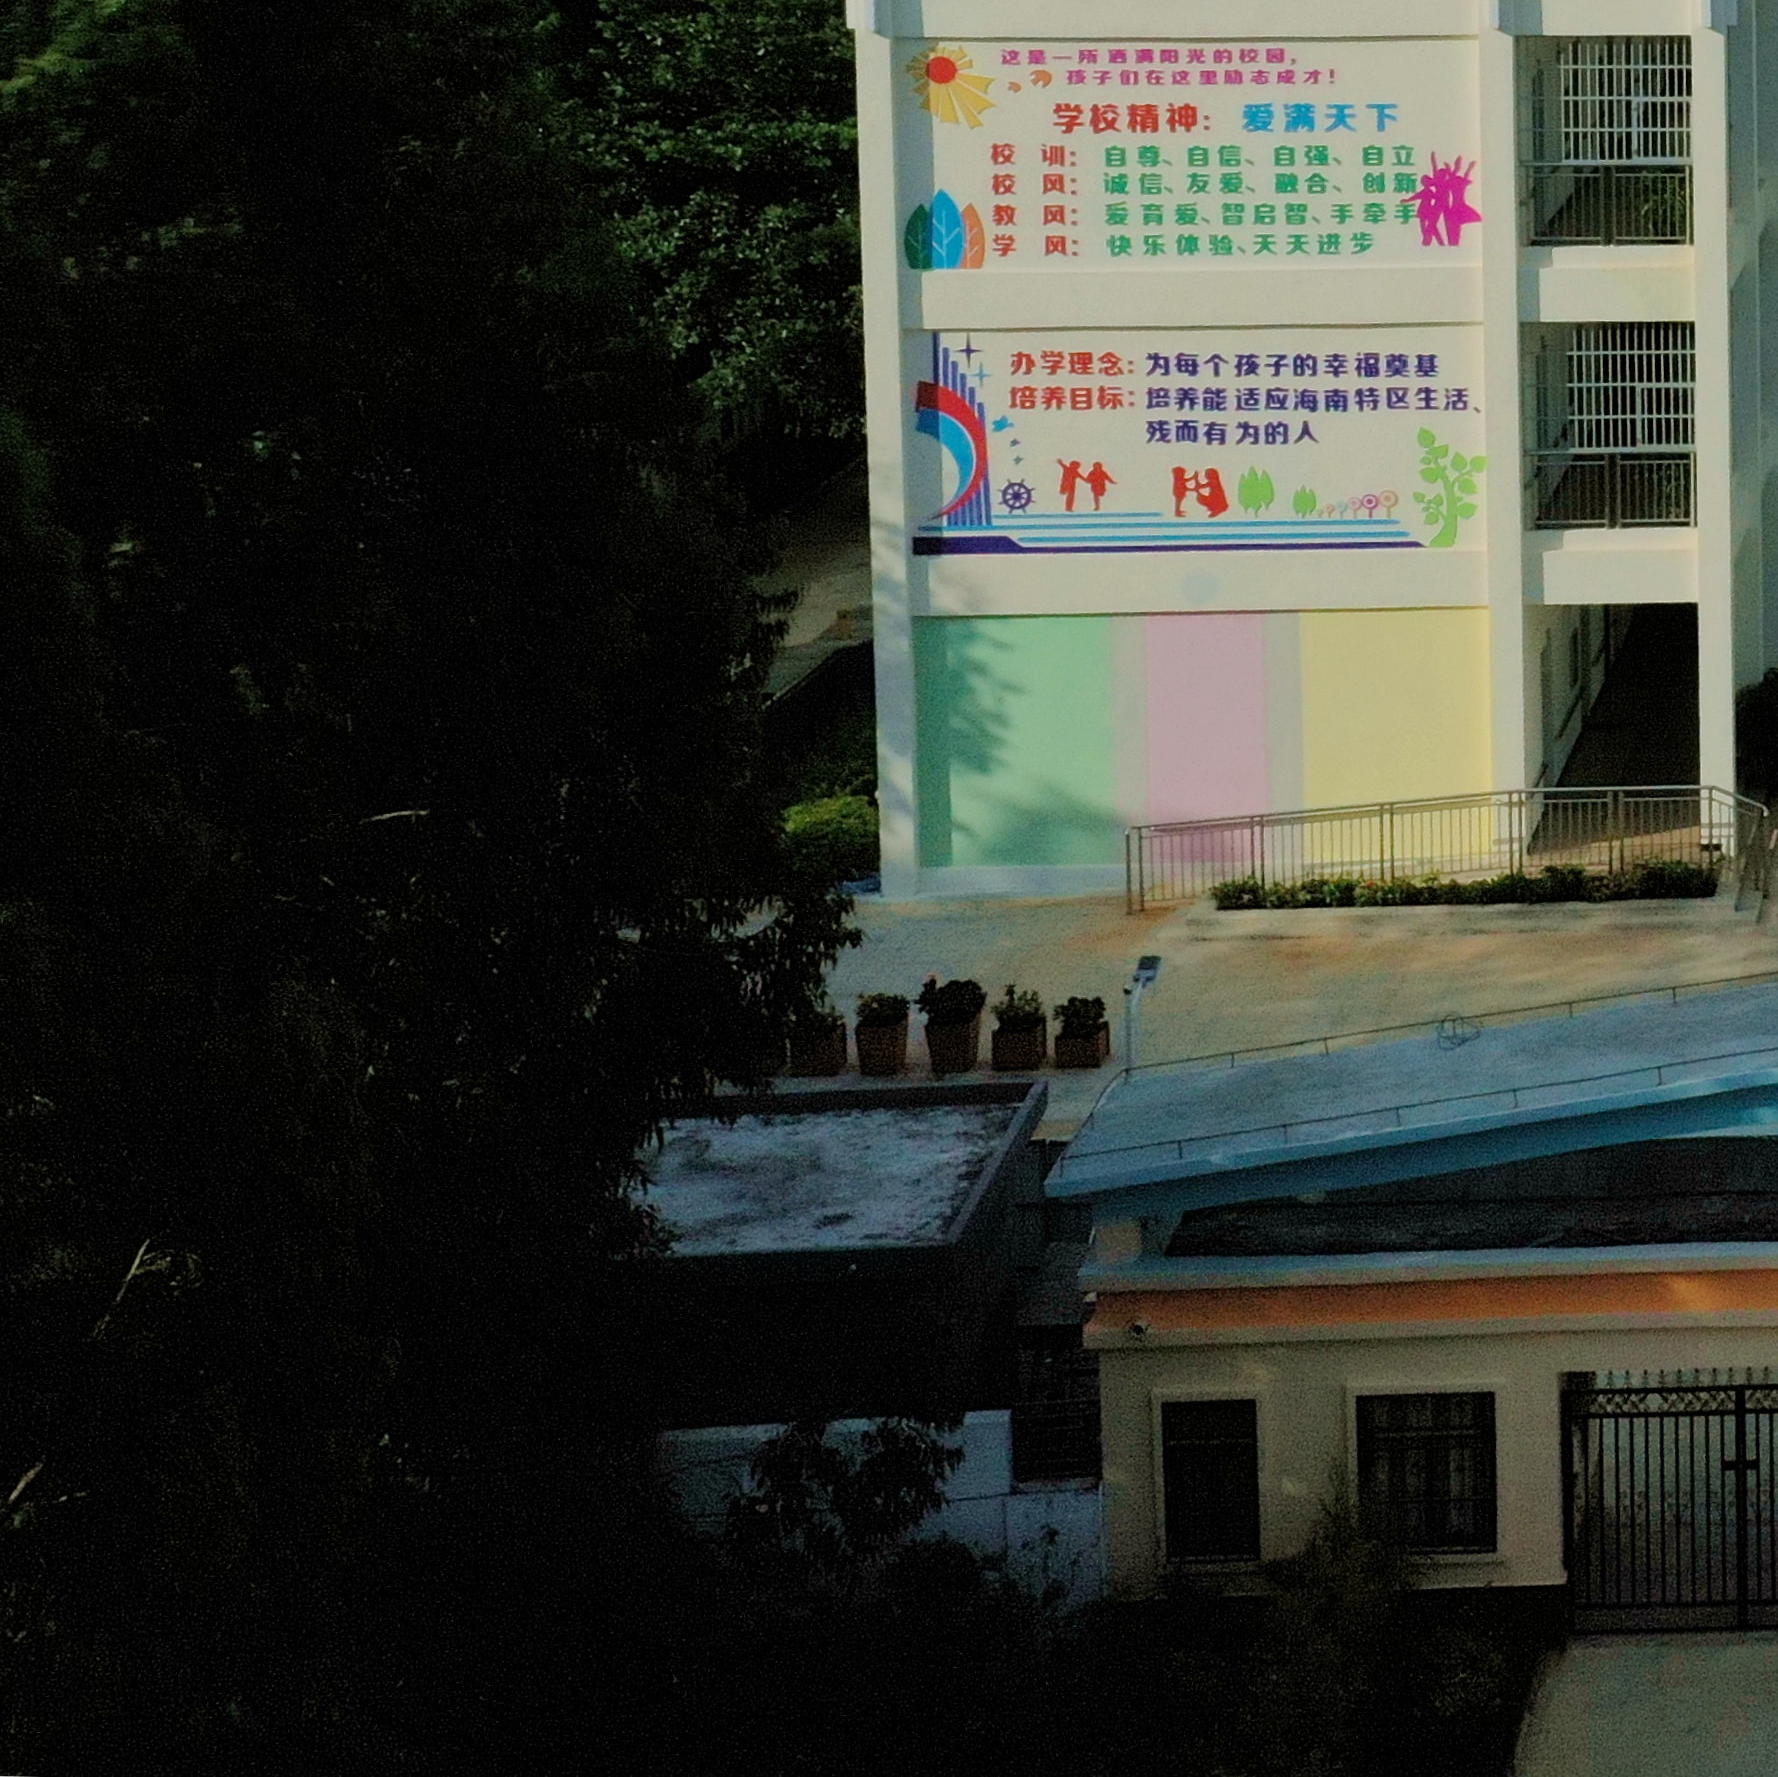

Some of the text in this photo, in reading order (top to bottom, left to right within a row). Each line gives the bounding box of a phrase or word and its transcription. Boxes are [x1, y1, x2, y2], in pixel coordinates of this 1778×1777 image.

[1052, 101, 1400, 136] 学校精神： 爱满天下
[1104, 144, 1416, 168] 自尊、自信、自强、自立
[1102, 171, 1420, 198] 诚信、友爱、融合、创新
[1103, 201, 1419, 227] 爱育爱、智启智、手牵手
[1107, 233, 1374, 258] 快乐体验、天天进步
[1008, 350, 1440, 378] 办学理念： 为每个孩子的幸福奠基
[1008, 385, 1482, 413] 培养目标： 培养能适应海南特区生活、
[1144, 420, 1320, 447] 残而有为的人
